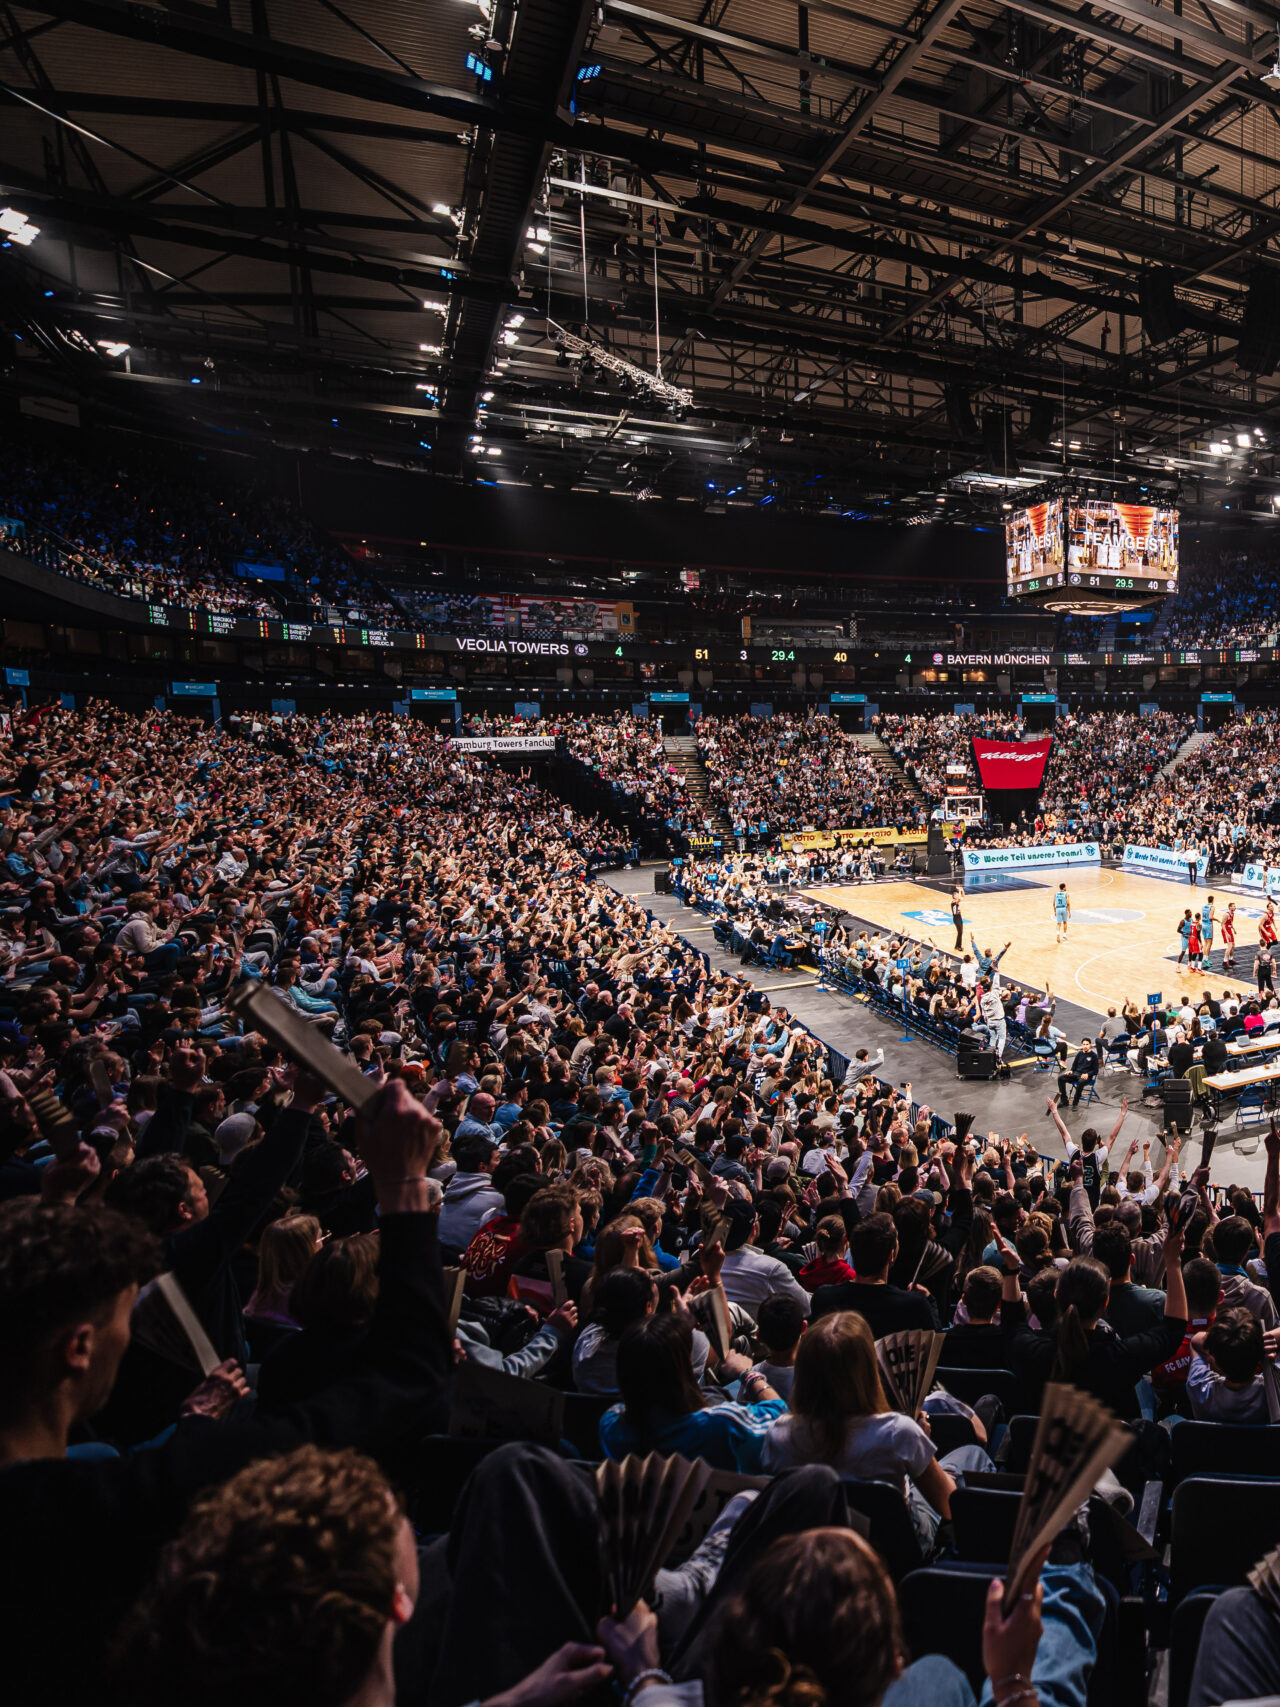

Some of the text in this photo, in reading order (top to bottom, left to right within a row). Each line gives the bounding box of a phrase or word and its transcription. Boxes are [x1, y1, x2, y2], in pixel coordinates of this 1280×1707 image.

[1012, 532, 1056, 555] TEAMGEIST
[1083, 531, 1166, 551] TEAMGEIST
[1090, 577, 1158, 590] 51 29.5 40
[456, 638, 569, 655] VEOLIA TOWERS
[615, 646, 623, 656] 4
[695, 649, 709, 660] 51
[740, 651, 747, 660] 3
[772, 651, 795, 661] 29.4
[834, 652, 847, 662] 40
[905, 654, 911, 663] 4
[947, 653, 1050, 664] BAYERN MÜNCHEN
[451, 740, 491, 750] Hamburg
[525, 738, 555, 747] Fanclub
[980, 752, 1046, 761] Kellogg's
[984, 854, 1009, 863] Werde
[1011, 853, 1025, 861] Teil
[1056, 849, 1082, 858] Teams!
[1164, 1356, 1190, 1373] FC BAY
